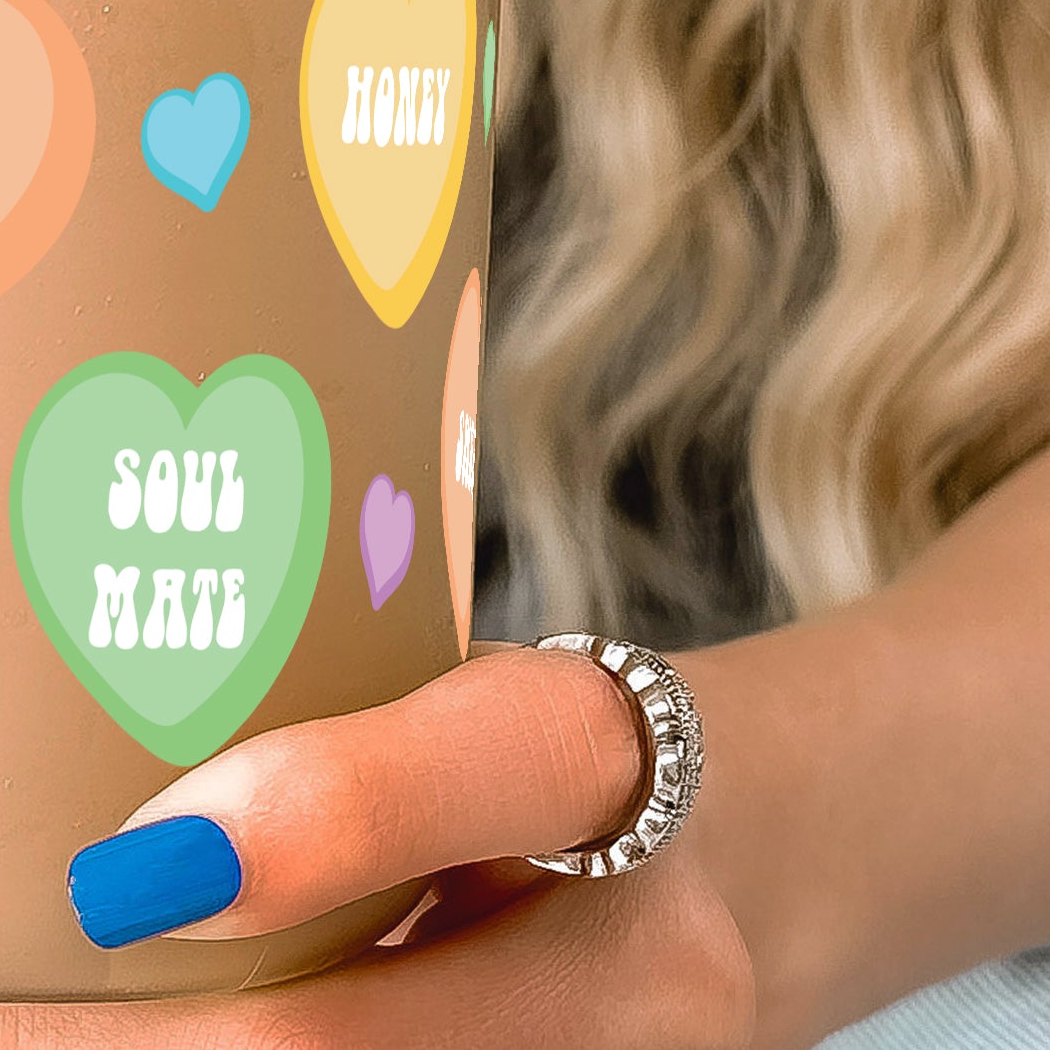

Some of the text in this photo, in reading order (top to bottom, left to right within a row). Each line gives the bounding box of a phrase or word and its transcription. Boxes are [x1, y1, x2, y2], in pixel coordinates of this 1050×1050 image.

[341, 66, 451, 147] HONEY
[108, 448, 245, 533] SOUL
[88, 563, 246, 650] MATE
